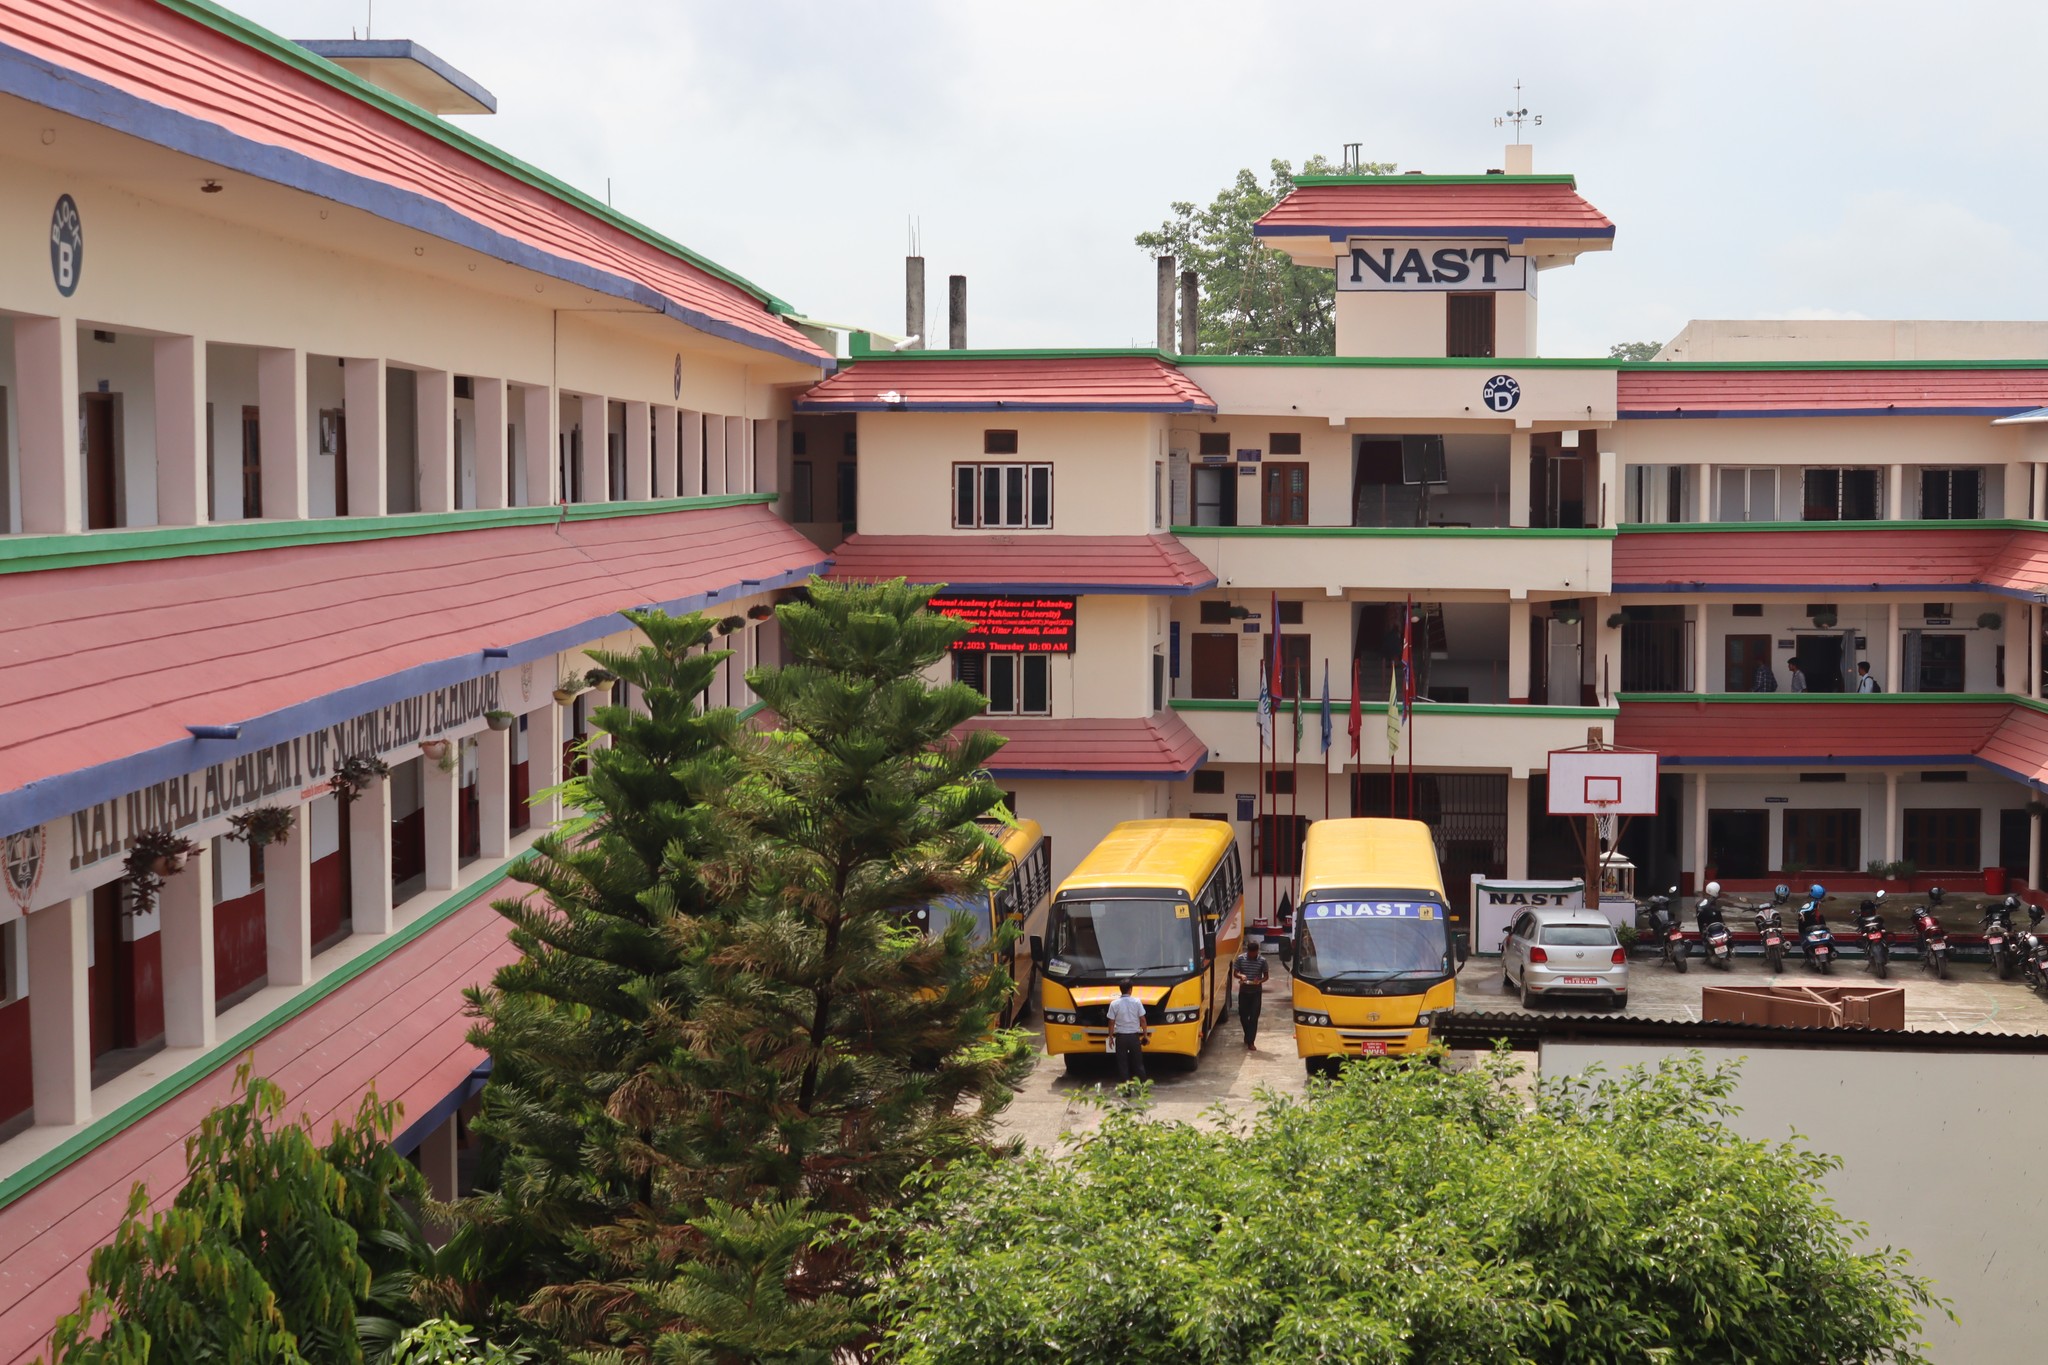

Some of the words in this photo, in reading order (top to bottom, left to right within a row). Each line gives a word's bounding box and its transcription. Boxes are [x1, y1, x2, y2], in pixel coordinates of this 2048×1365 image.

[52, 201, 81, 250] BLOCK
[59, 241, 73, 288] B
[1350, 247, 1510, 283] NAST
[1484, 376, 1519, 399] BLOCK
[1494, 391, 1513, 411] D
[928, 599, 957, 607] National
[958, 599, 988, 609] Academy
[997, 599, 1021, 608] Science
[1021, 600, 1035, 608] and
[1036, 600, 1073, 610] Technology
[988, 609, 1020, 618] Pokhara
[989, 641, 1024, 652] Thursday
[1052, 643, 1069, 651] AM
[1489, 892, 1569, 906] NAST
[1335, 904, 1411, 916] NAST
